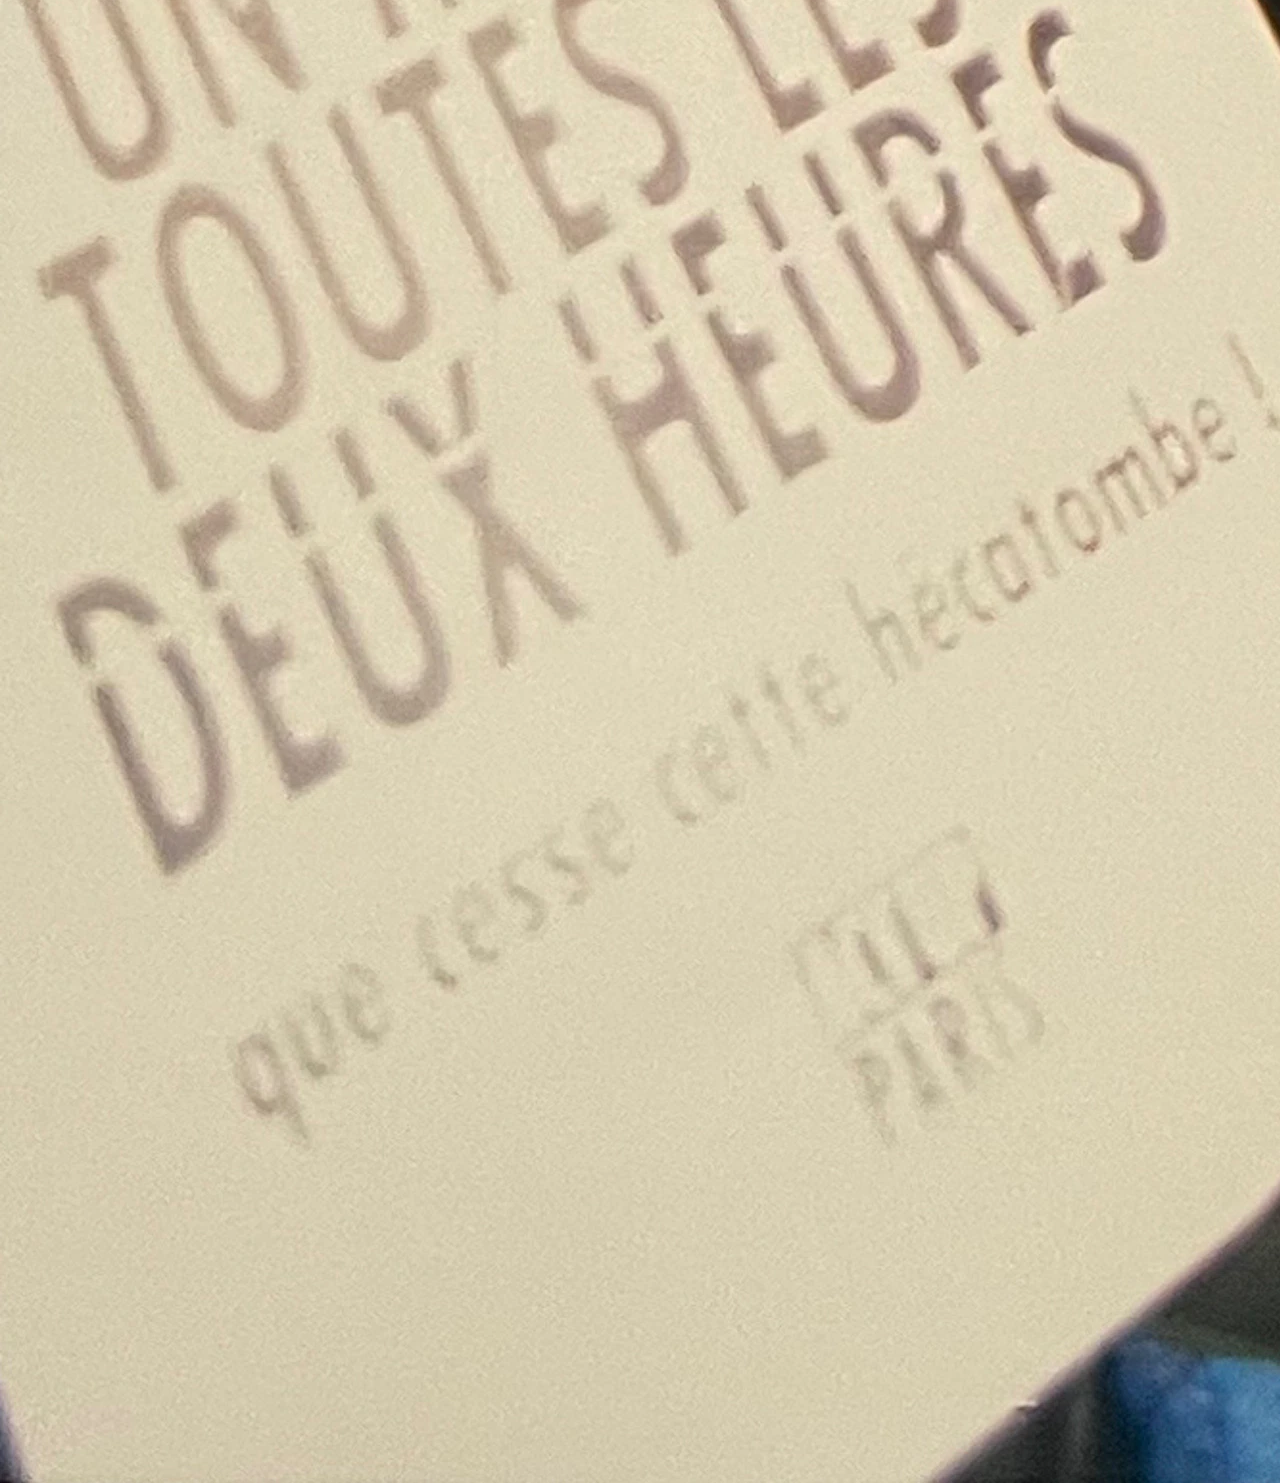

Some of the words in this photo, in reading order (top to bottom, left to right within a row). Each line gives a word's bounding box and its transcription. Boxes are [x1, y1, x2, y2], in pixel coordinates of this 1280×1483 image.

[55, 356, 588, 878] DEUX
[558, 8, 1170, 557] HEURES
[230, 960, 394, 1147] que
[416, 798, 635, 991] cesse
[652, 650, 853, 830] cette
